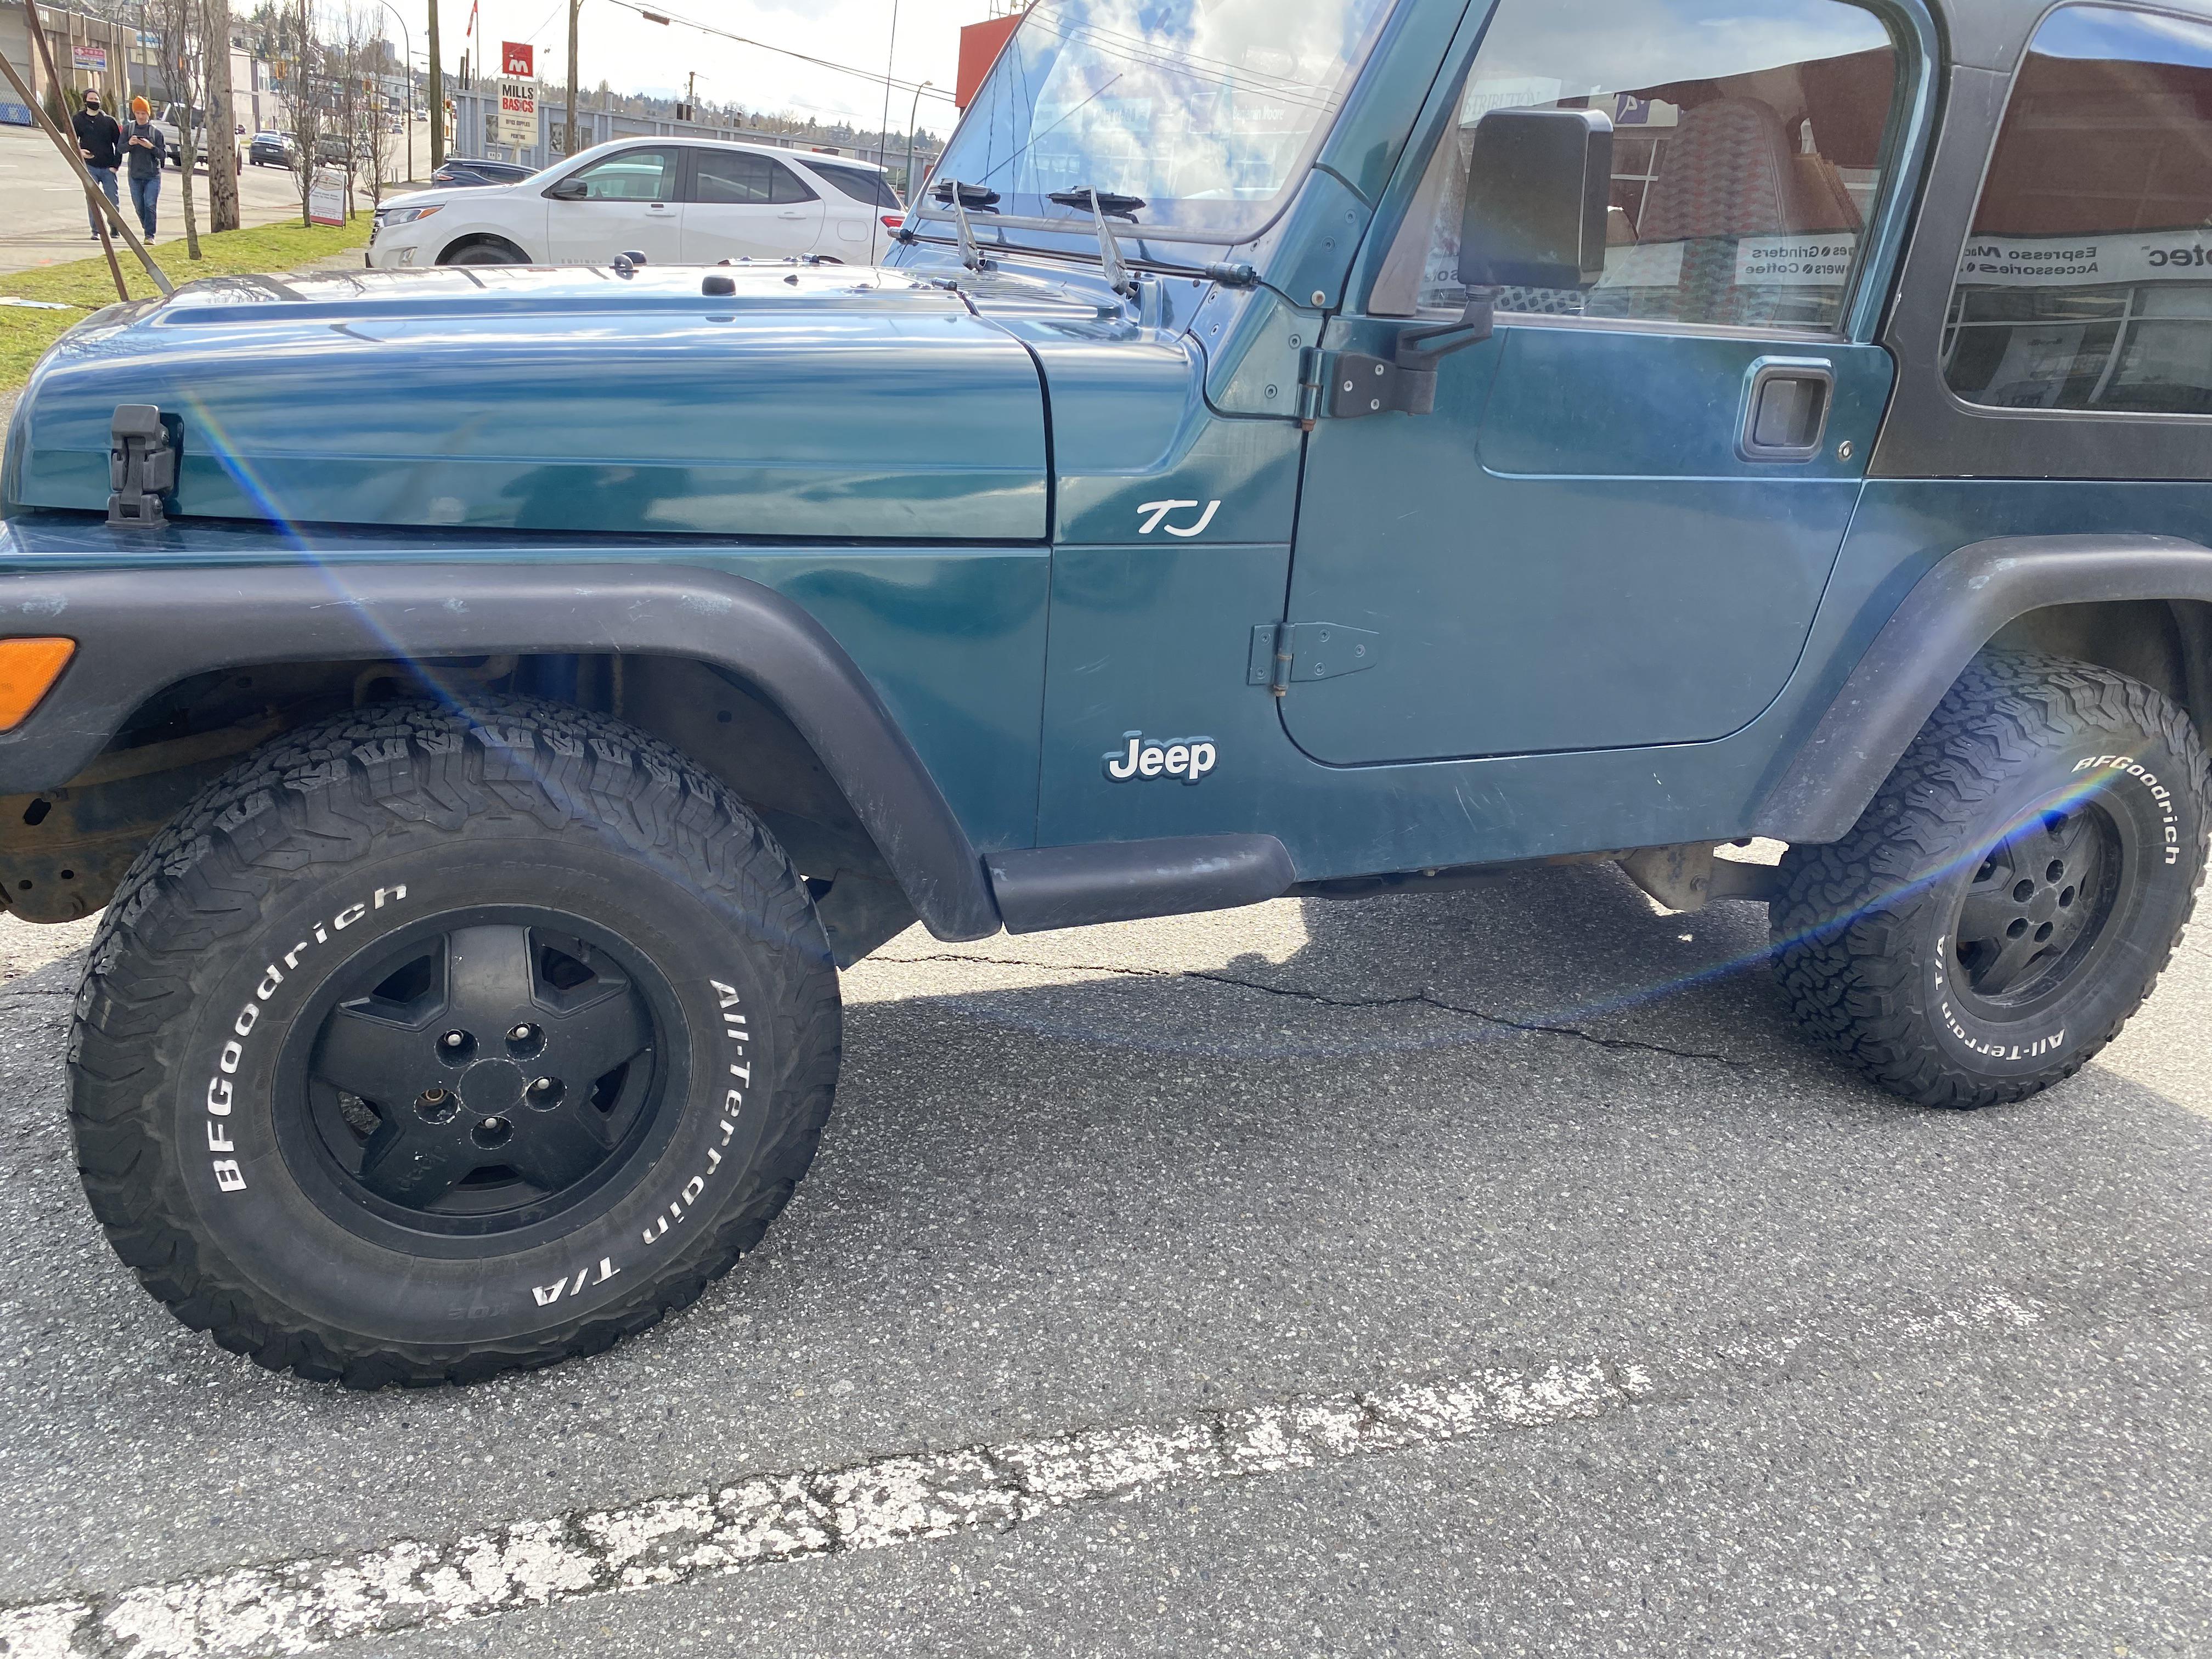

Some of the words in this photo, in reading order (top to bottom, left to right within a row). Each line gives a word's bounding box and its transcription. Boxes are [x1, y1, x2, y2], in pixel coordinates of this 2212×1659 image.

[503, 84, 534, 100] MILLS
[1137, 499, 1221, 537] TJ
[1109, 738, 1216, 780] Jeep
[2070, 755, 2180, 865] BFGoodrich
[1934, 934, 1946, 991] T/A
[207, 883, 408, 1193] BFGoodrich
[1942, 1001, 2066, 1061] All-Terrain
[641, 978, 751, 1245] All-Terrain
[531, 1256, 622, 1307] T/A
